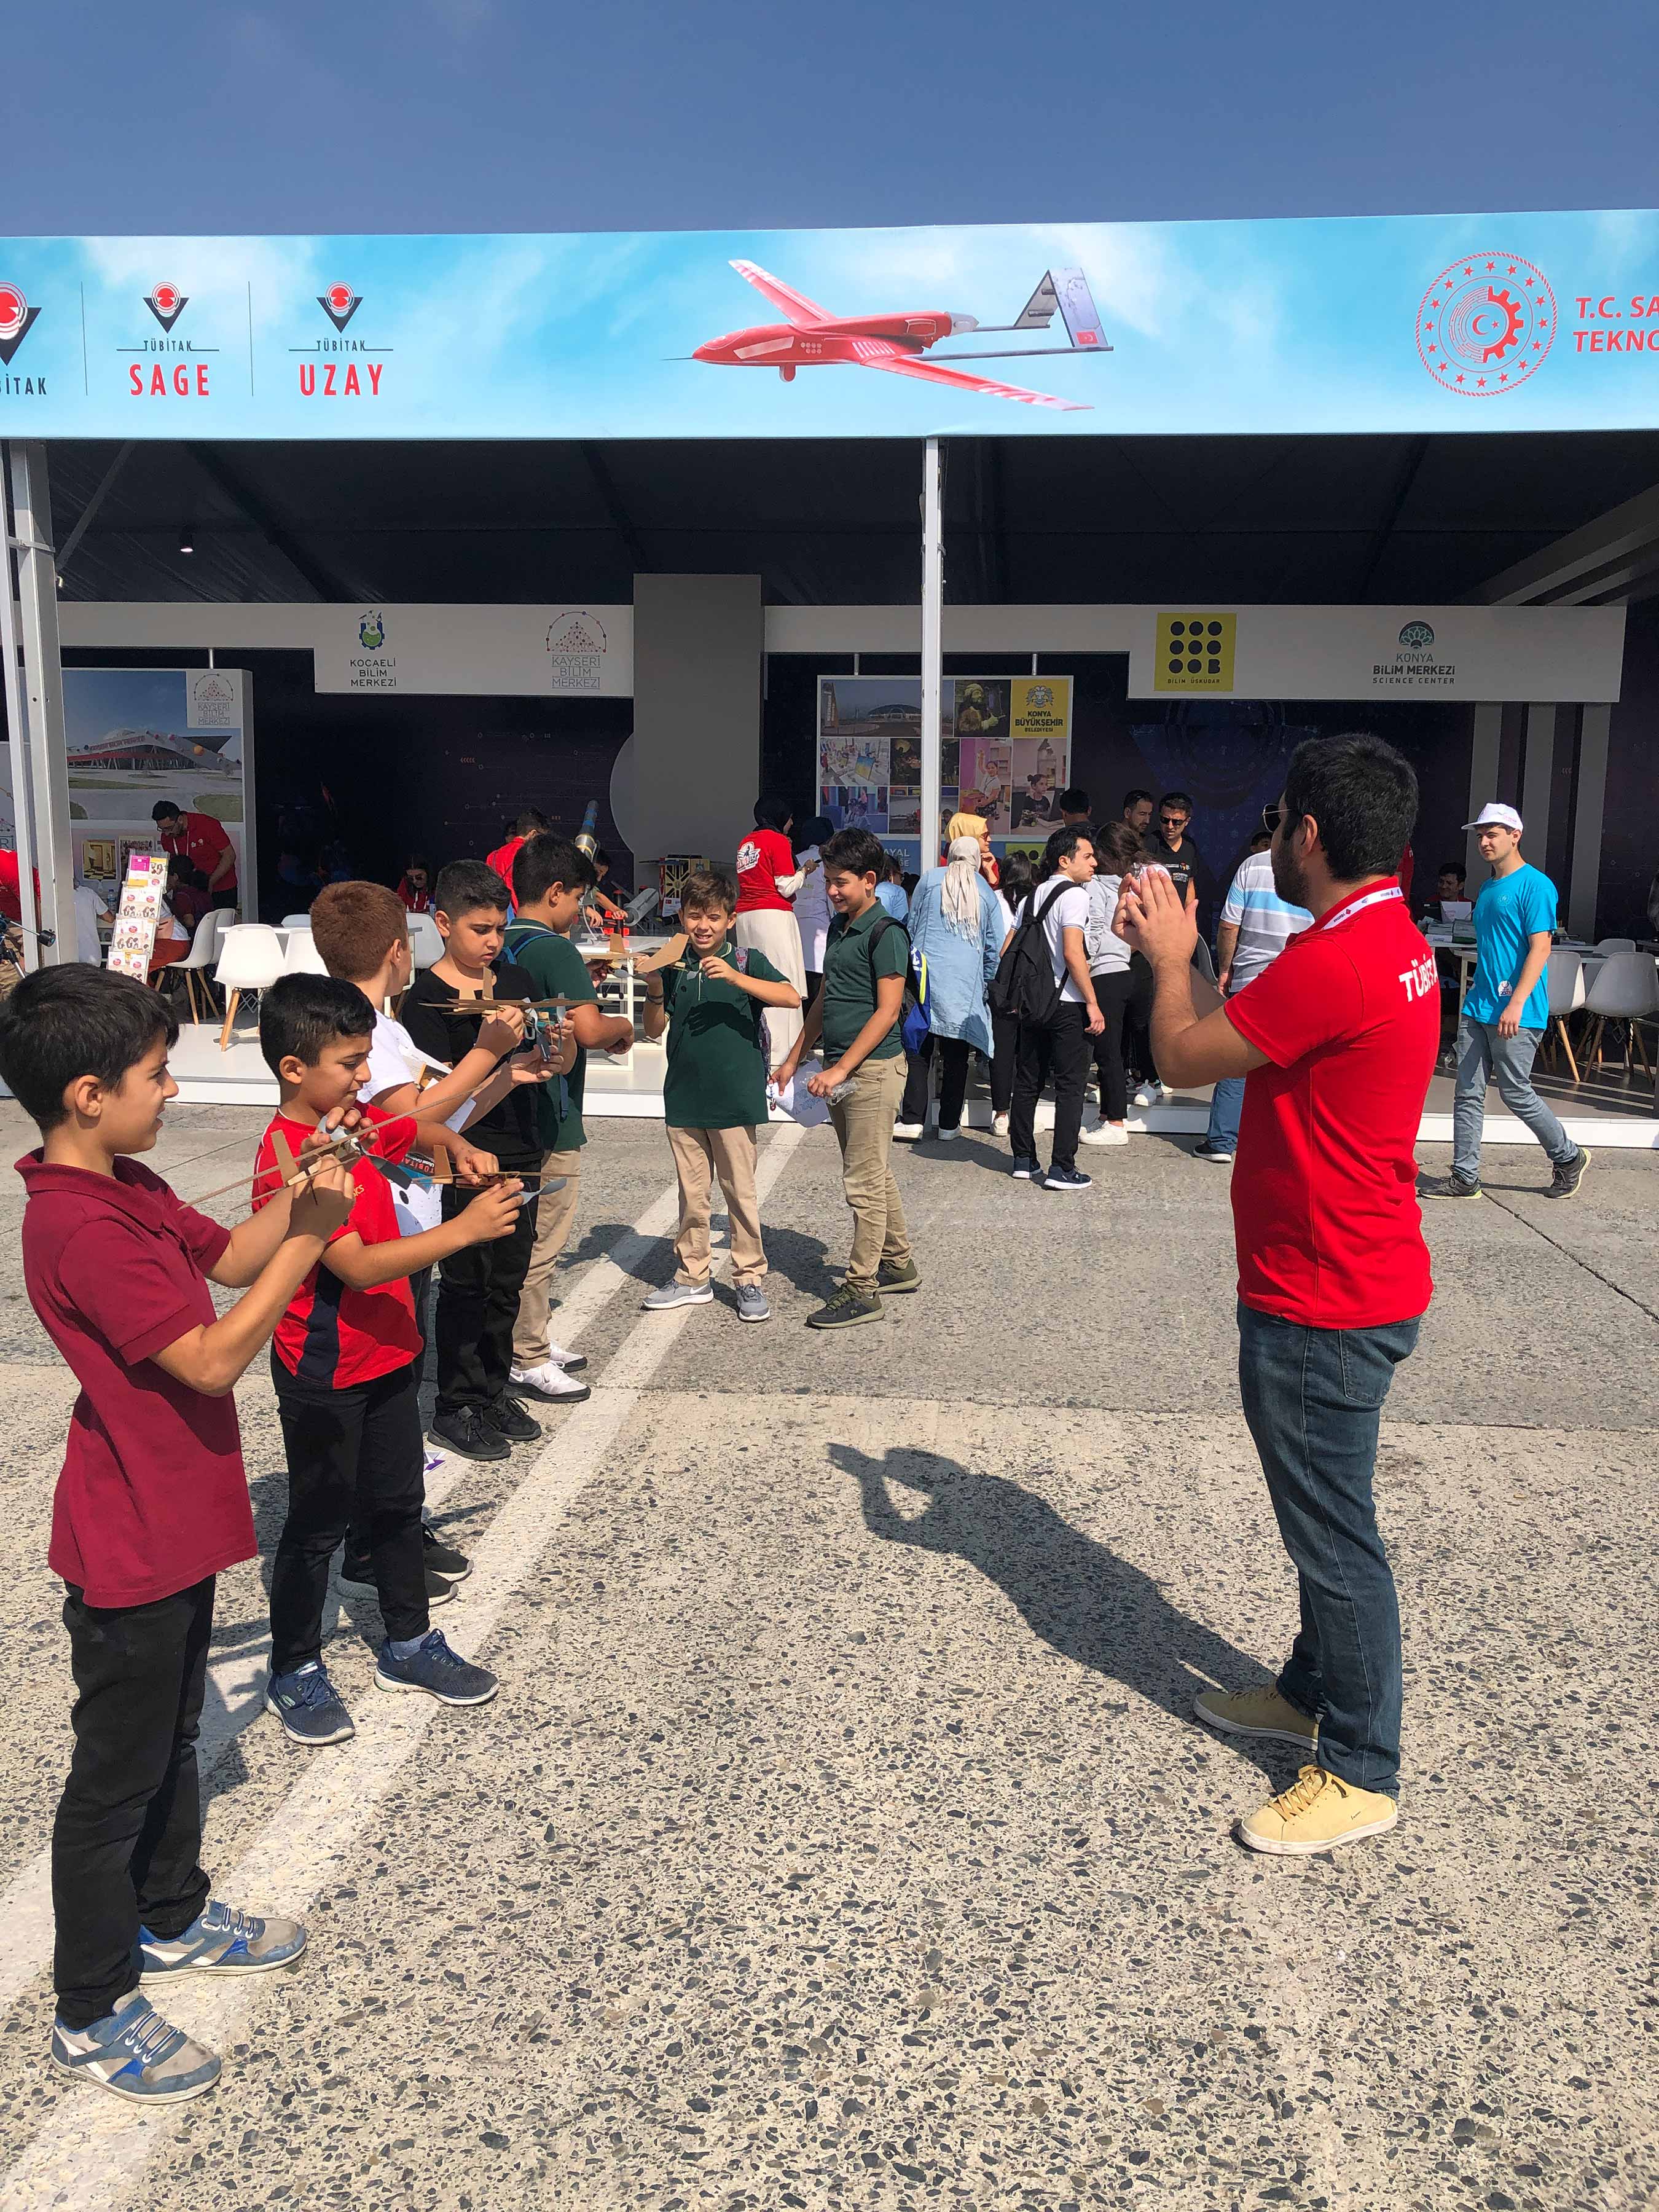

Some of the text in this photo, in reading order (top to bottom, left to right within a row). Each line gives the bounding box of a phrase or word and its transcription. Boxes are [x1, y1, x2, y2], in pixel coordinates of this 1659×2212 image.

[1575, 296, 1622, 319] T.C.
[143, 338, 192, 352] TÜBİTAK
[316, 337, 366, 351] TÜBİTAK
[0, 373, 47, 395] İTAK
[129, 364, 210, 396] SAGE
[299, 364, 383, 396] UZAY
[350, 657, 396, 667] KOCAELİ
[551, 655, 600, 666] KAYSERİ
[1395, 653, 1434, 663] KONYA
[359, 667, 388, 677] BİLİM
[350, 677, 397, 687] MERKEZİ
[551, 677, 600, 688] MERKEZİ
[1015, 717, 1064, 727] BÜYÜKŞEHİR
[884, 848, 910, 857] AYAL
